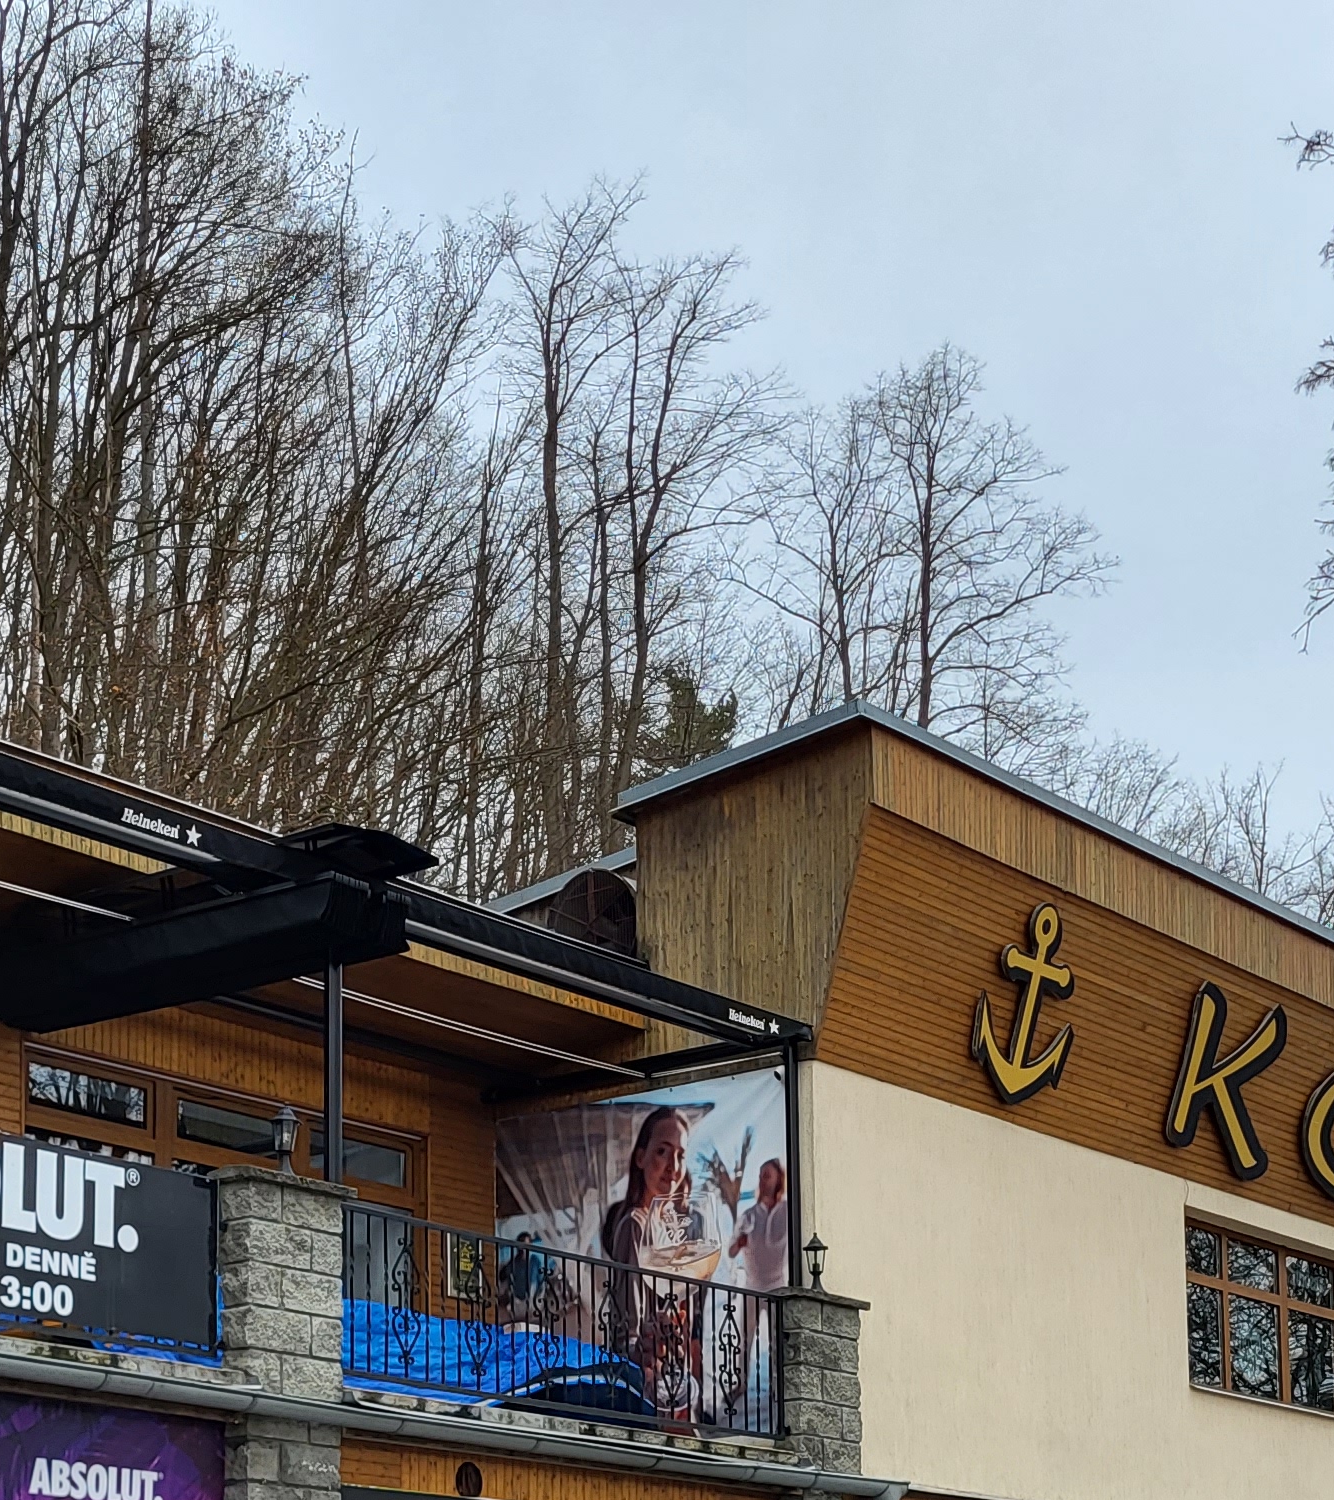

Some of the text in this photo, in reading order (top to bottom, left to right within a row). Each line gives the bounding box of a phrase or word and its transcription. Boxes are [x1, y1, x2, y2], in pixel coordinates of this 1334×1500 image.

[120, 807, 180, 839] Heineken
[728, 1008, 765, 1031] Heineken
[5, 1241, 97, 1283] DENNĚ
[0, 1275, 75, 1317] 3:00
